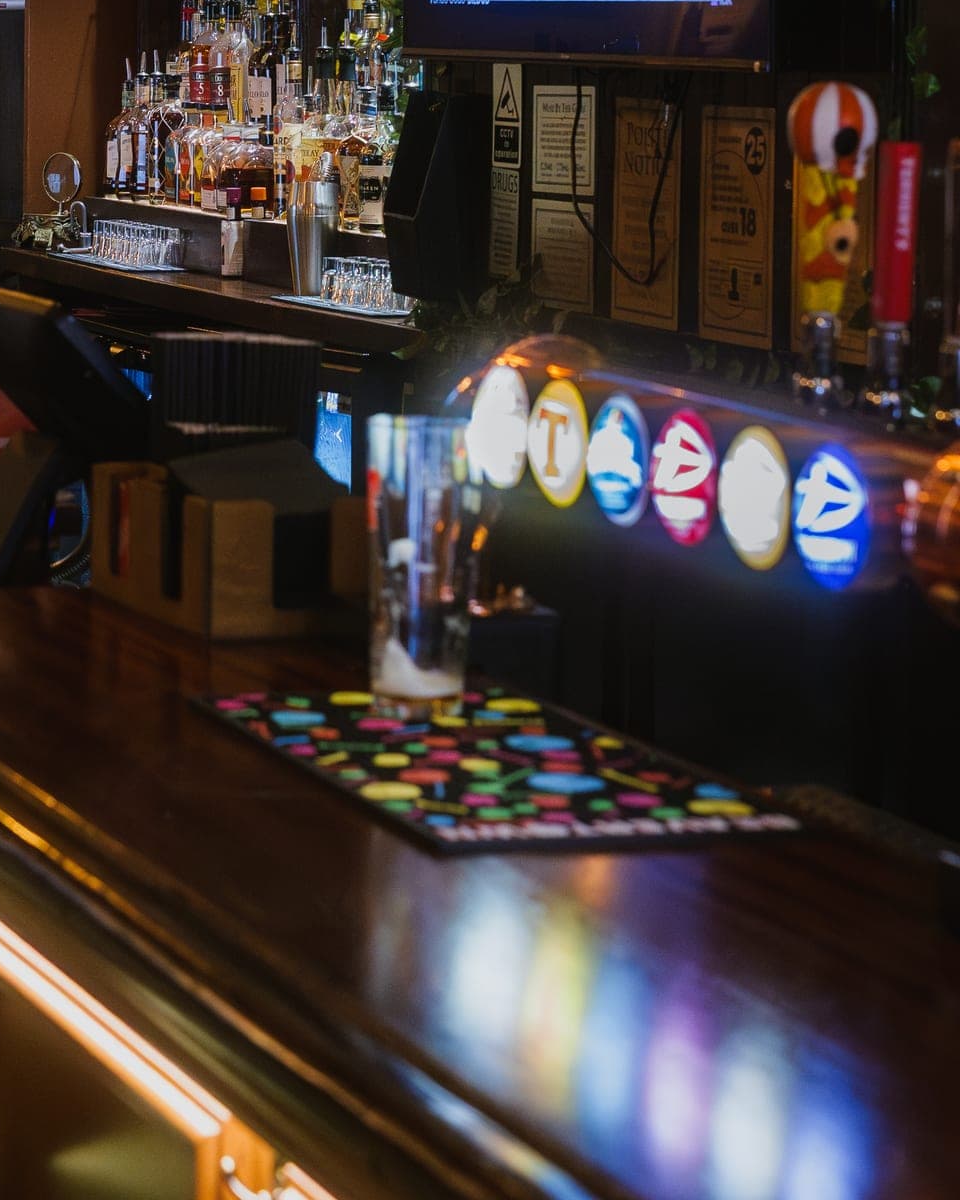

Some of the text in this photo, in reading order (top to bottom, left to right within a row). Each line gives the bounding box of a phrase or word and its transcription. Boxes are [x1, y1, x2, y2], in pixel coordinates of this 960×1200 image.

[197, 82, 205, 95] 5
[217, 84, 224, 97] 8
[746, 133, 765, 166] 25
[624, 152, 672, 177] NOTI
[491, 171, 519, 193] DRUGS
[739, 206, 757, 238] 18
